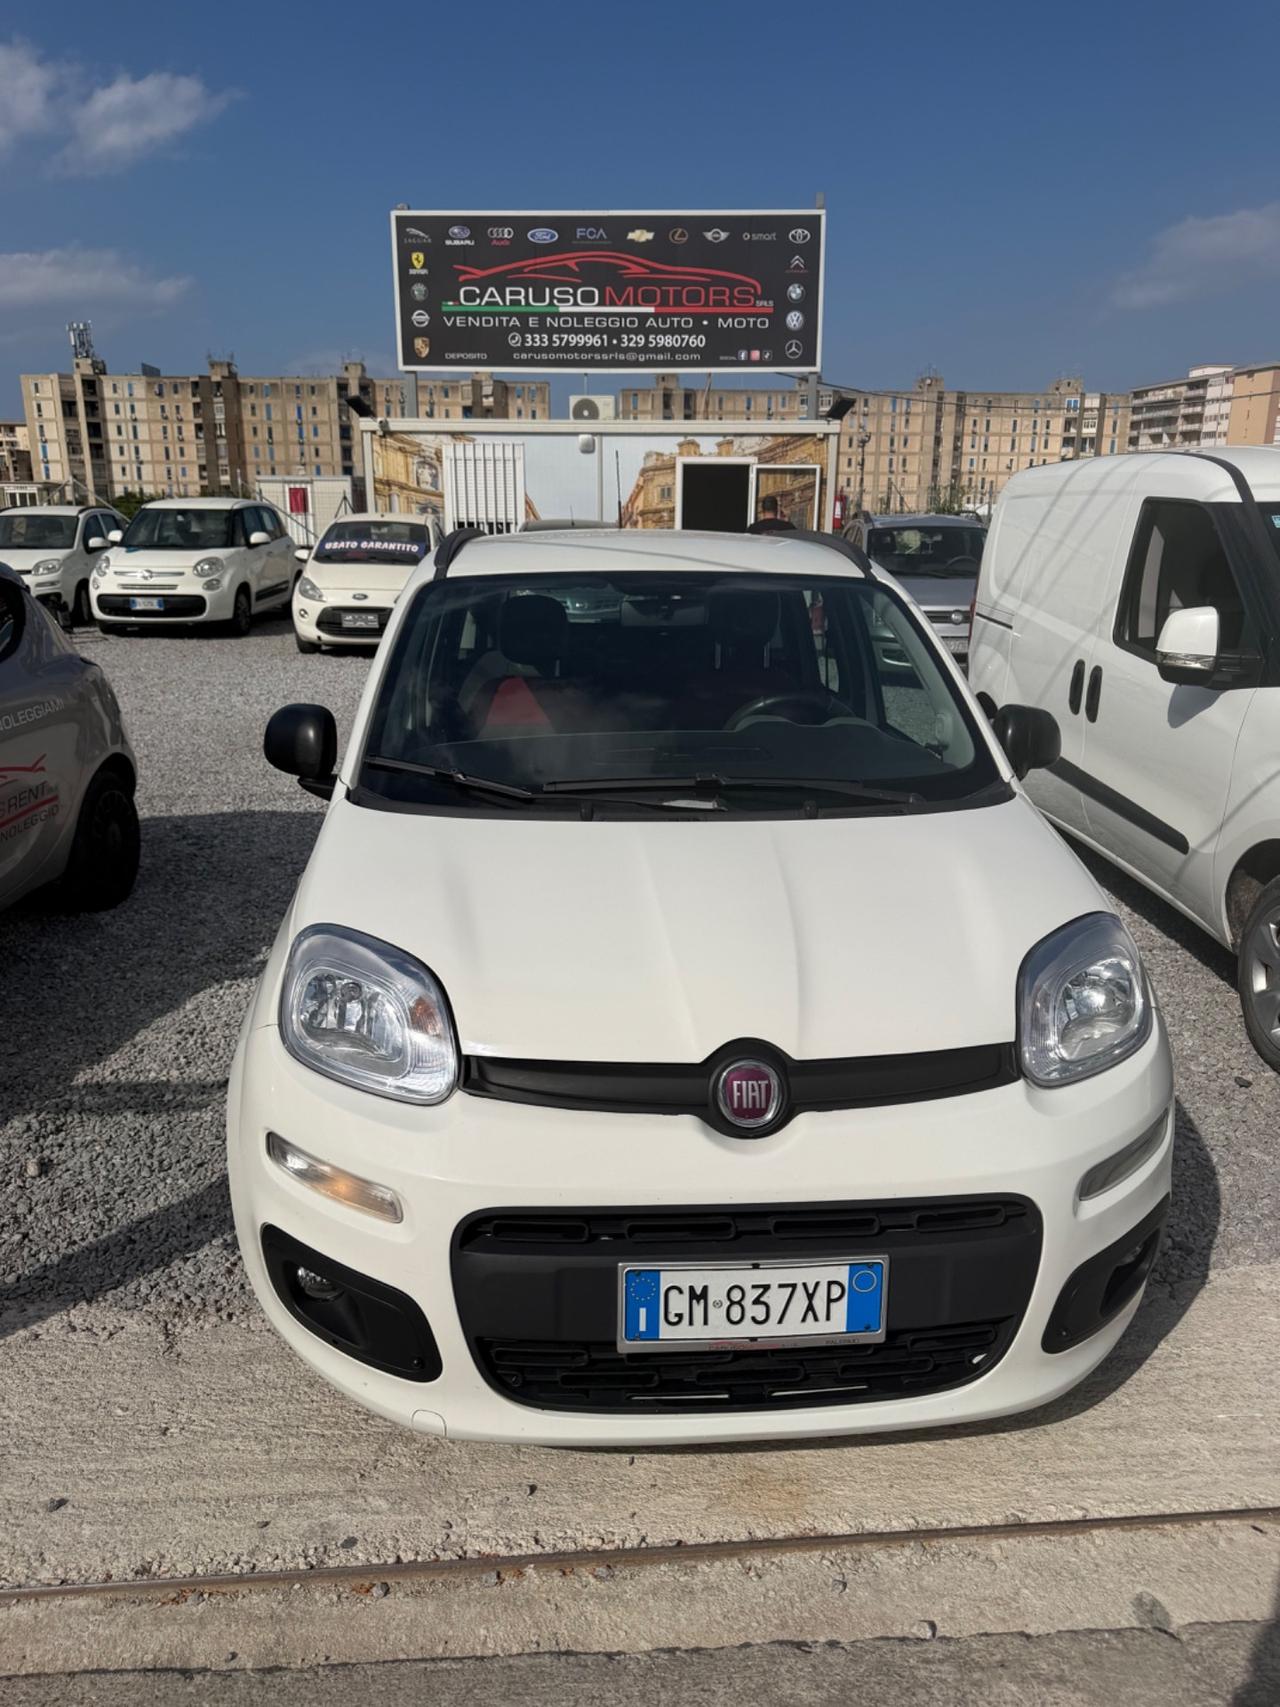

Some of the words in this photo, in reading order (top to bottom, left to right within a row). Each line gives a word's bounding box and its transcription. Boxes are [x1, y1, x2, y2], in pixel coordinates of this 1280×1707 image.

[576, 228, 607, 240] FCA
[459, 286, 599, 307] CARUSO
[605, 286, 755, 307] MOTORS
[443, 316, 521, 328] VENDITA
[529, 317, 539, 328] E
[547, 317, 639, 329] NOLEGGIO
[645, 317, 693, 329] AUTO
[717, 317, 770, 329] MOTO
[524, 334, 549, 347] 333
[552, 334, 608, 347] 5799961
[620, 334, 647, 347] 329
[648, 334, 706, 348] 5980760
[445, 352, 488, 360] DEPOSITO
[513, 351, 701, 362] carusomotorssrls@gmail.com
[324, 540, 358, 550] USATO
[360, 540, 420, 553] GARANTITO
[732, 1080, 769, 1109] FIAT
